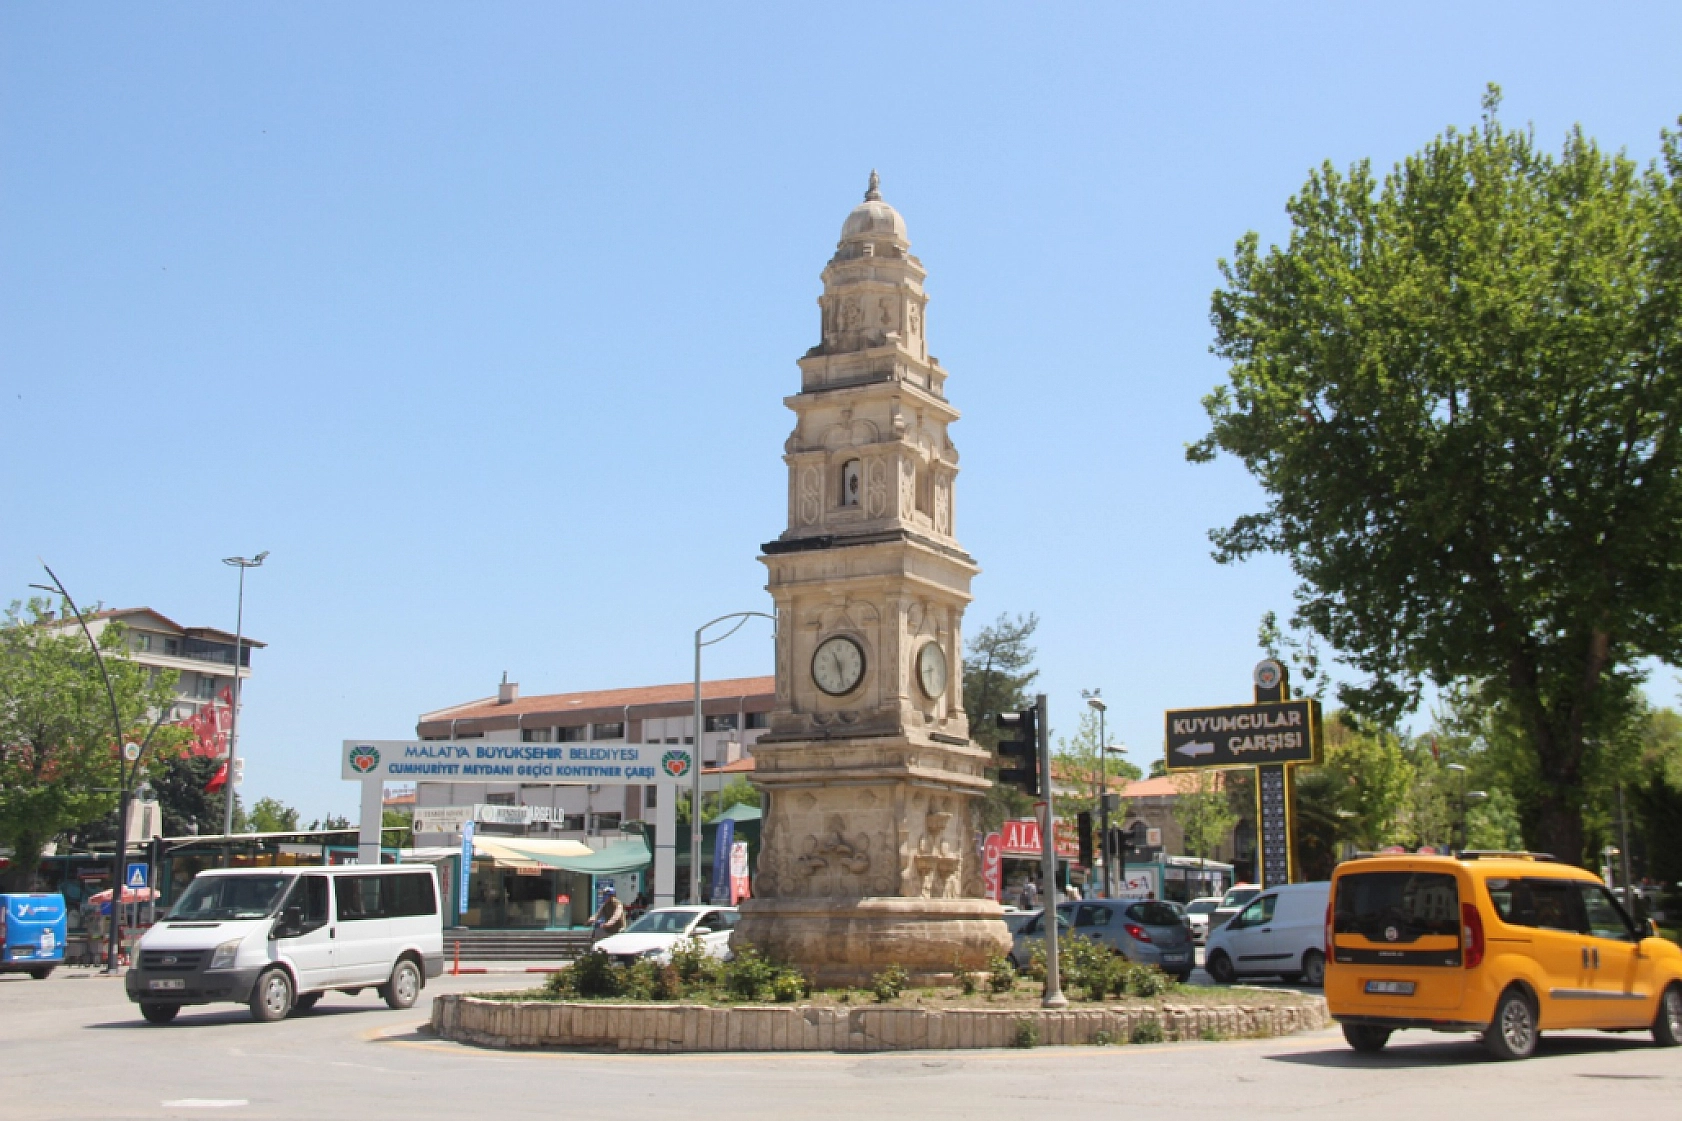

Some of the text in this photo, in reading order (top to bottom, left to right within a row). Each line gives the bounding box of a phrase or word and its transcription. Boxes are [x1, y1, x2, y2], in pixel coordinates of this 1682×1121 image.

[1173, 710, 1301, 735] KUYUMCULAR
[405, 746, 470, 758] MALATYA
[1228, 732, 1302, 755] ÇARŞISI
[388, 761, 656, 780] CUMHURİYET MEYDANI GEÇİCİ KONTEYNER ÇARŞI
